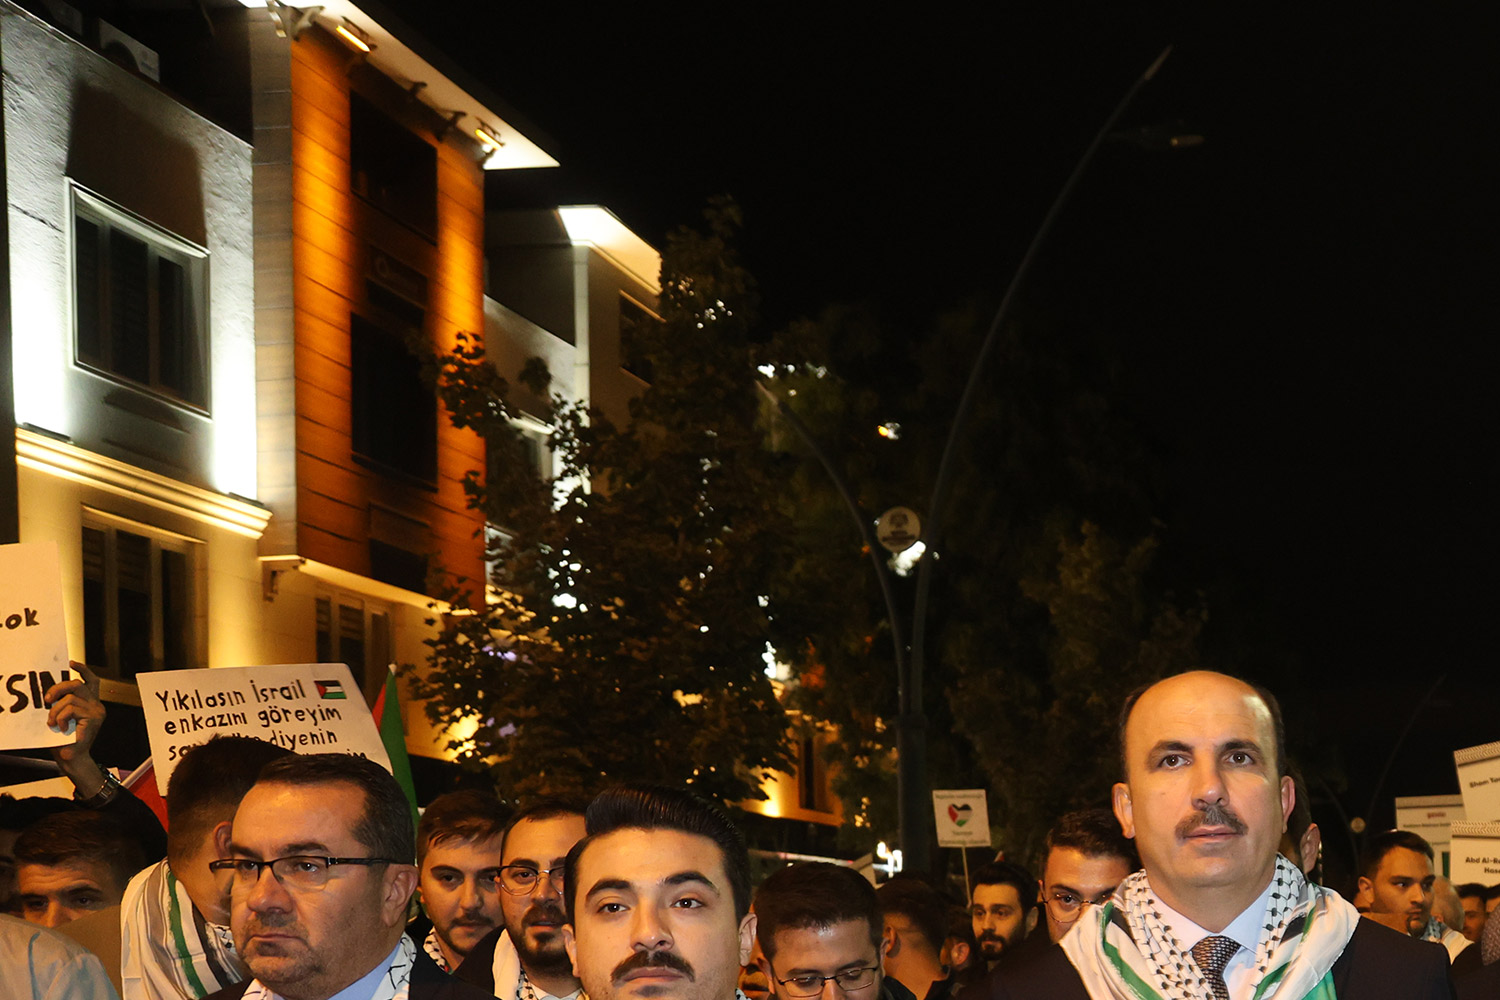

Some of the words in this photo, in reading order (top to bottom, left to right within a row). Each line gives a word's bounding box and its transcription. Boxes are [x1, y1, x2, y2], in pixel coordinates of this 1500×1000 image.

[155, 688, 246, 712] Yıkılasın
[250, 679, 306, 704] İsrail
[164, 711, 248, 736] enkazını
[258, 704, 342, 728] göreyim
